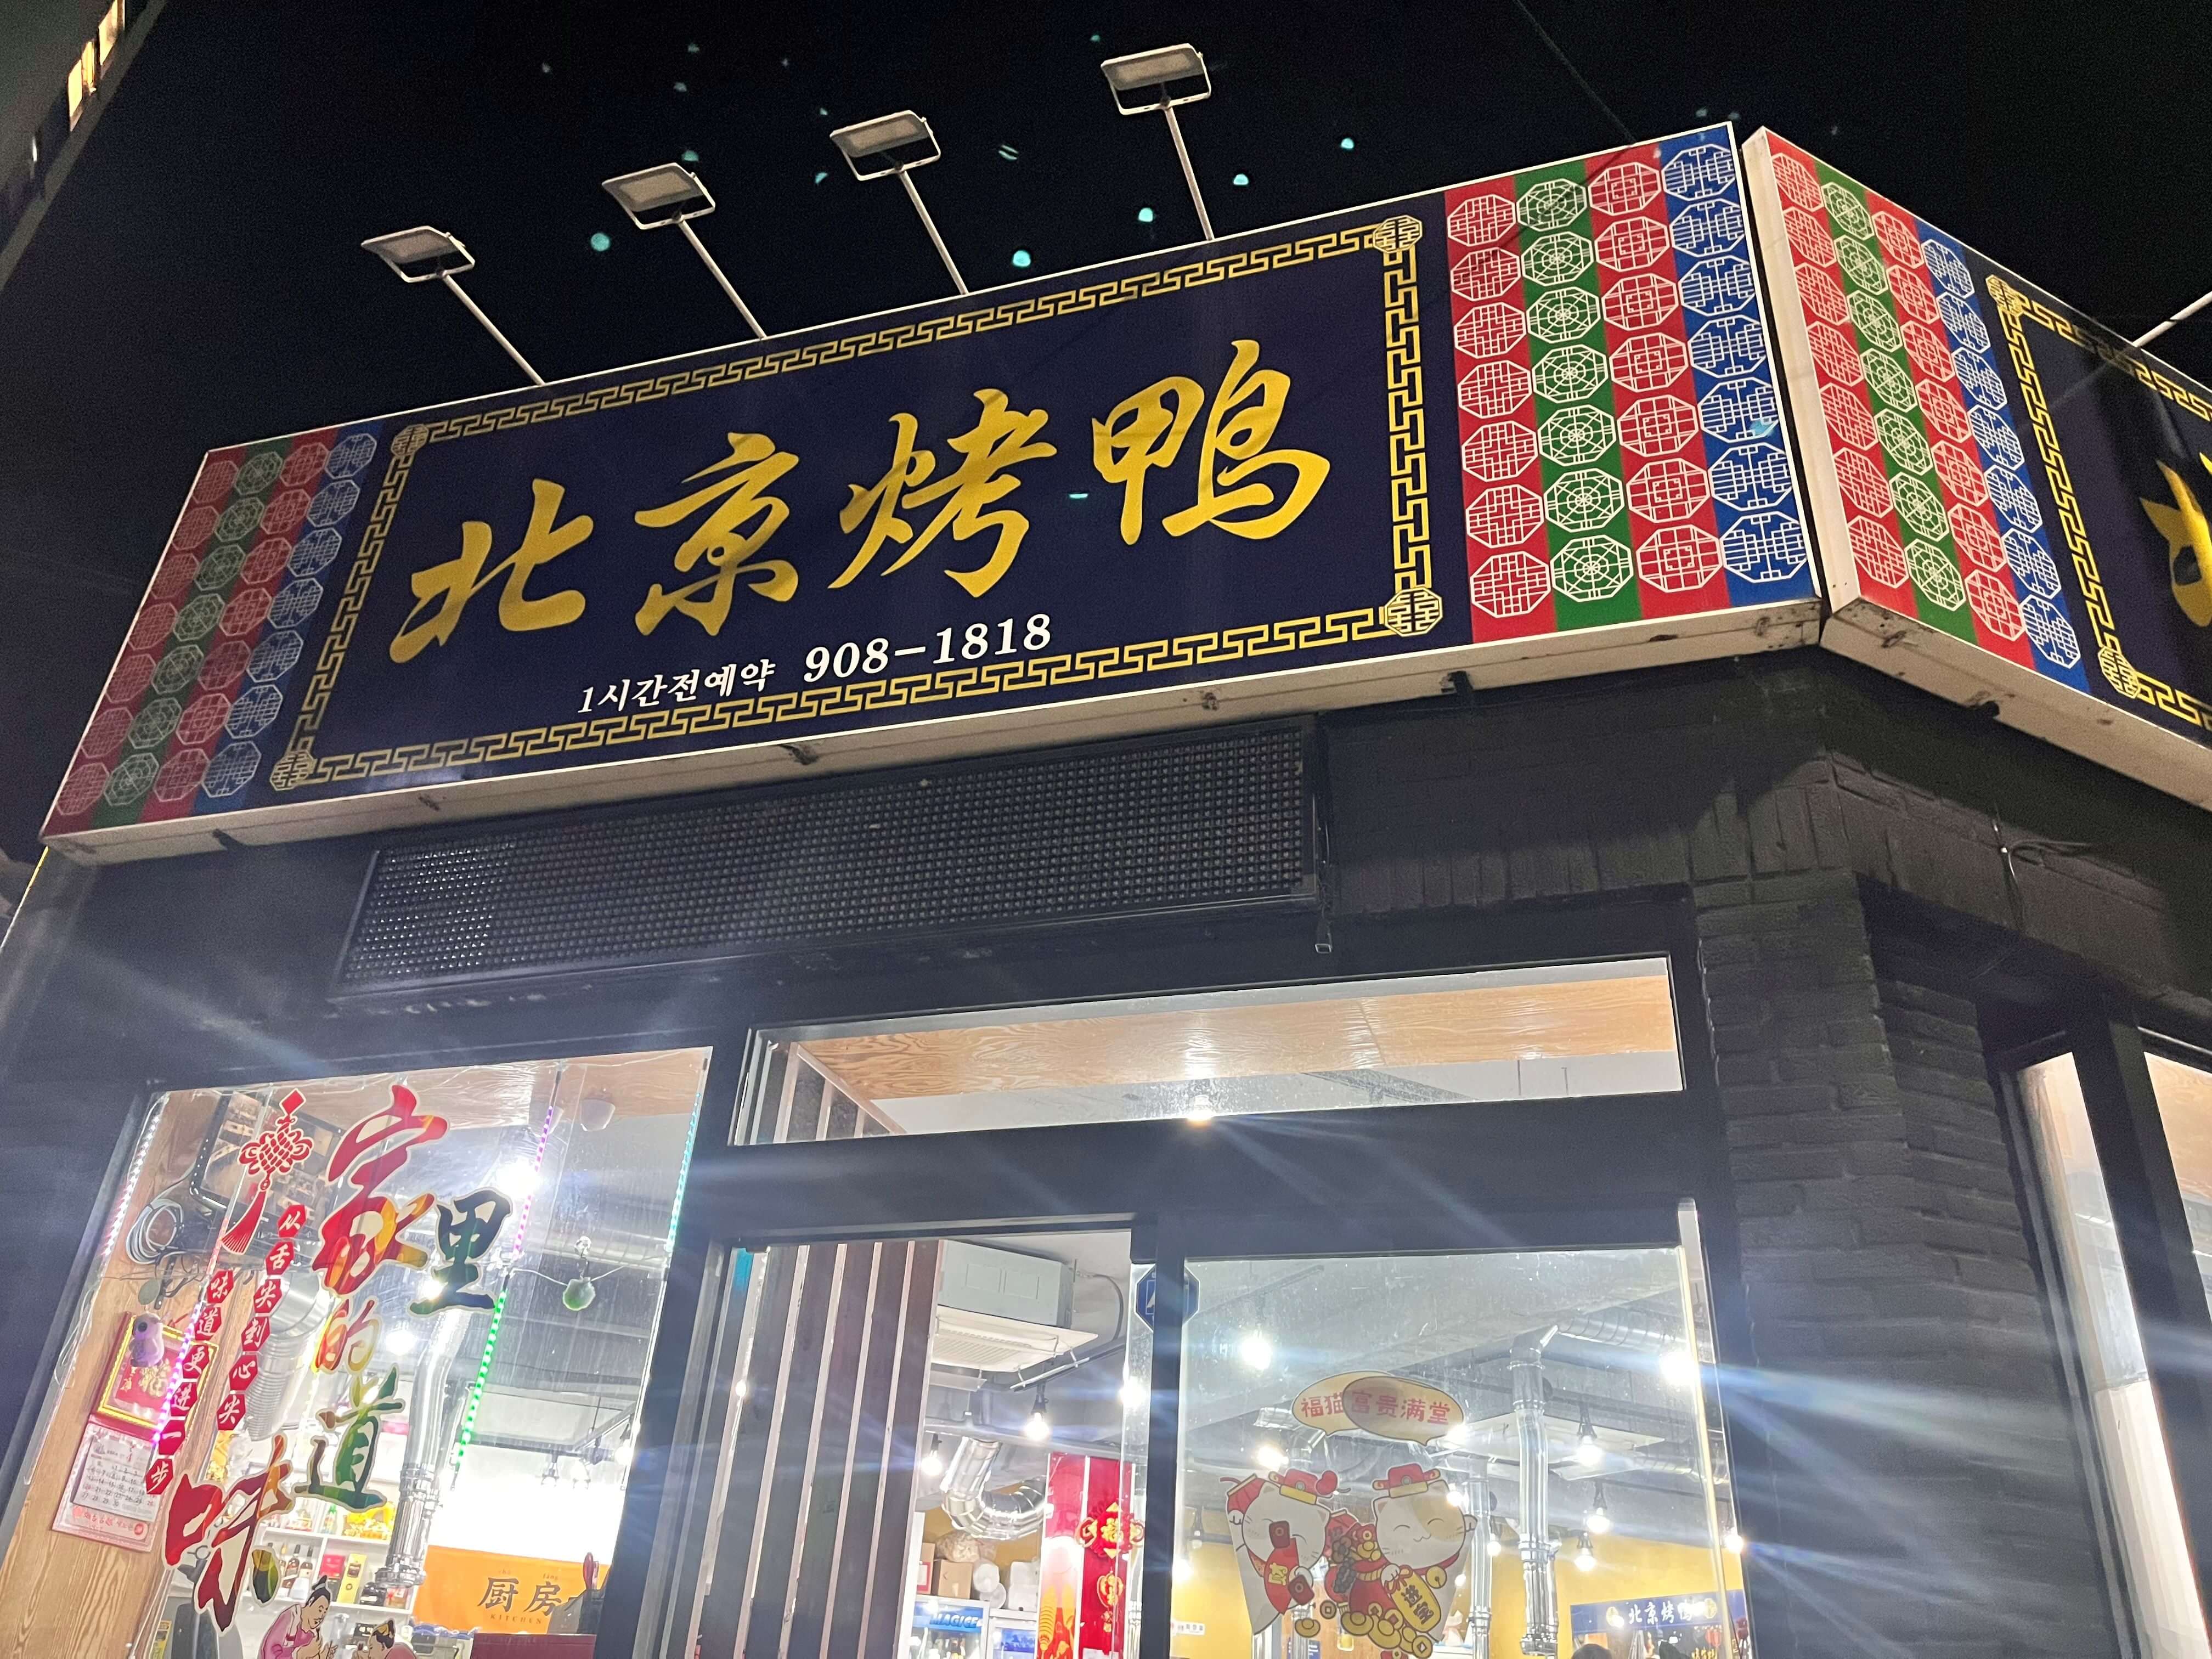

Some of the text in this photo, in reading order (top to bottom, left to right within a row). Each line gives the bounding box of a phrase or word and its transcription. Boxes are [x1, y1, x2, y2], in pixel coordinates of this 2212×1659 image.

[578, 613, 1051, 713] 1시간전예약 908-1818
[1351, 1390, 1451, 1426] 富贵满堂
[477, 1577, 562, 1616] 厨房
[490, 1613, 542, 1624] KITCHEN
